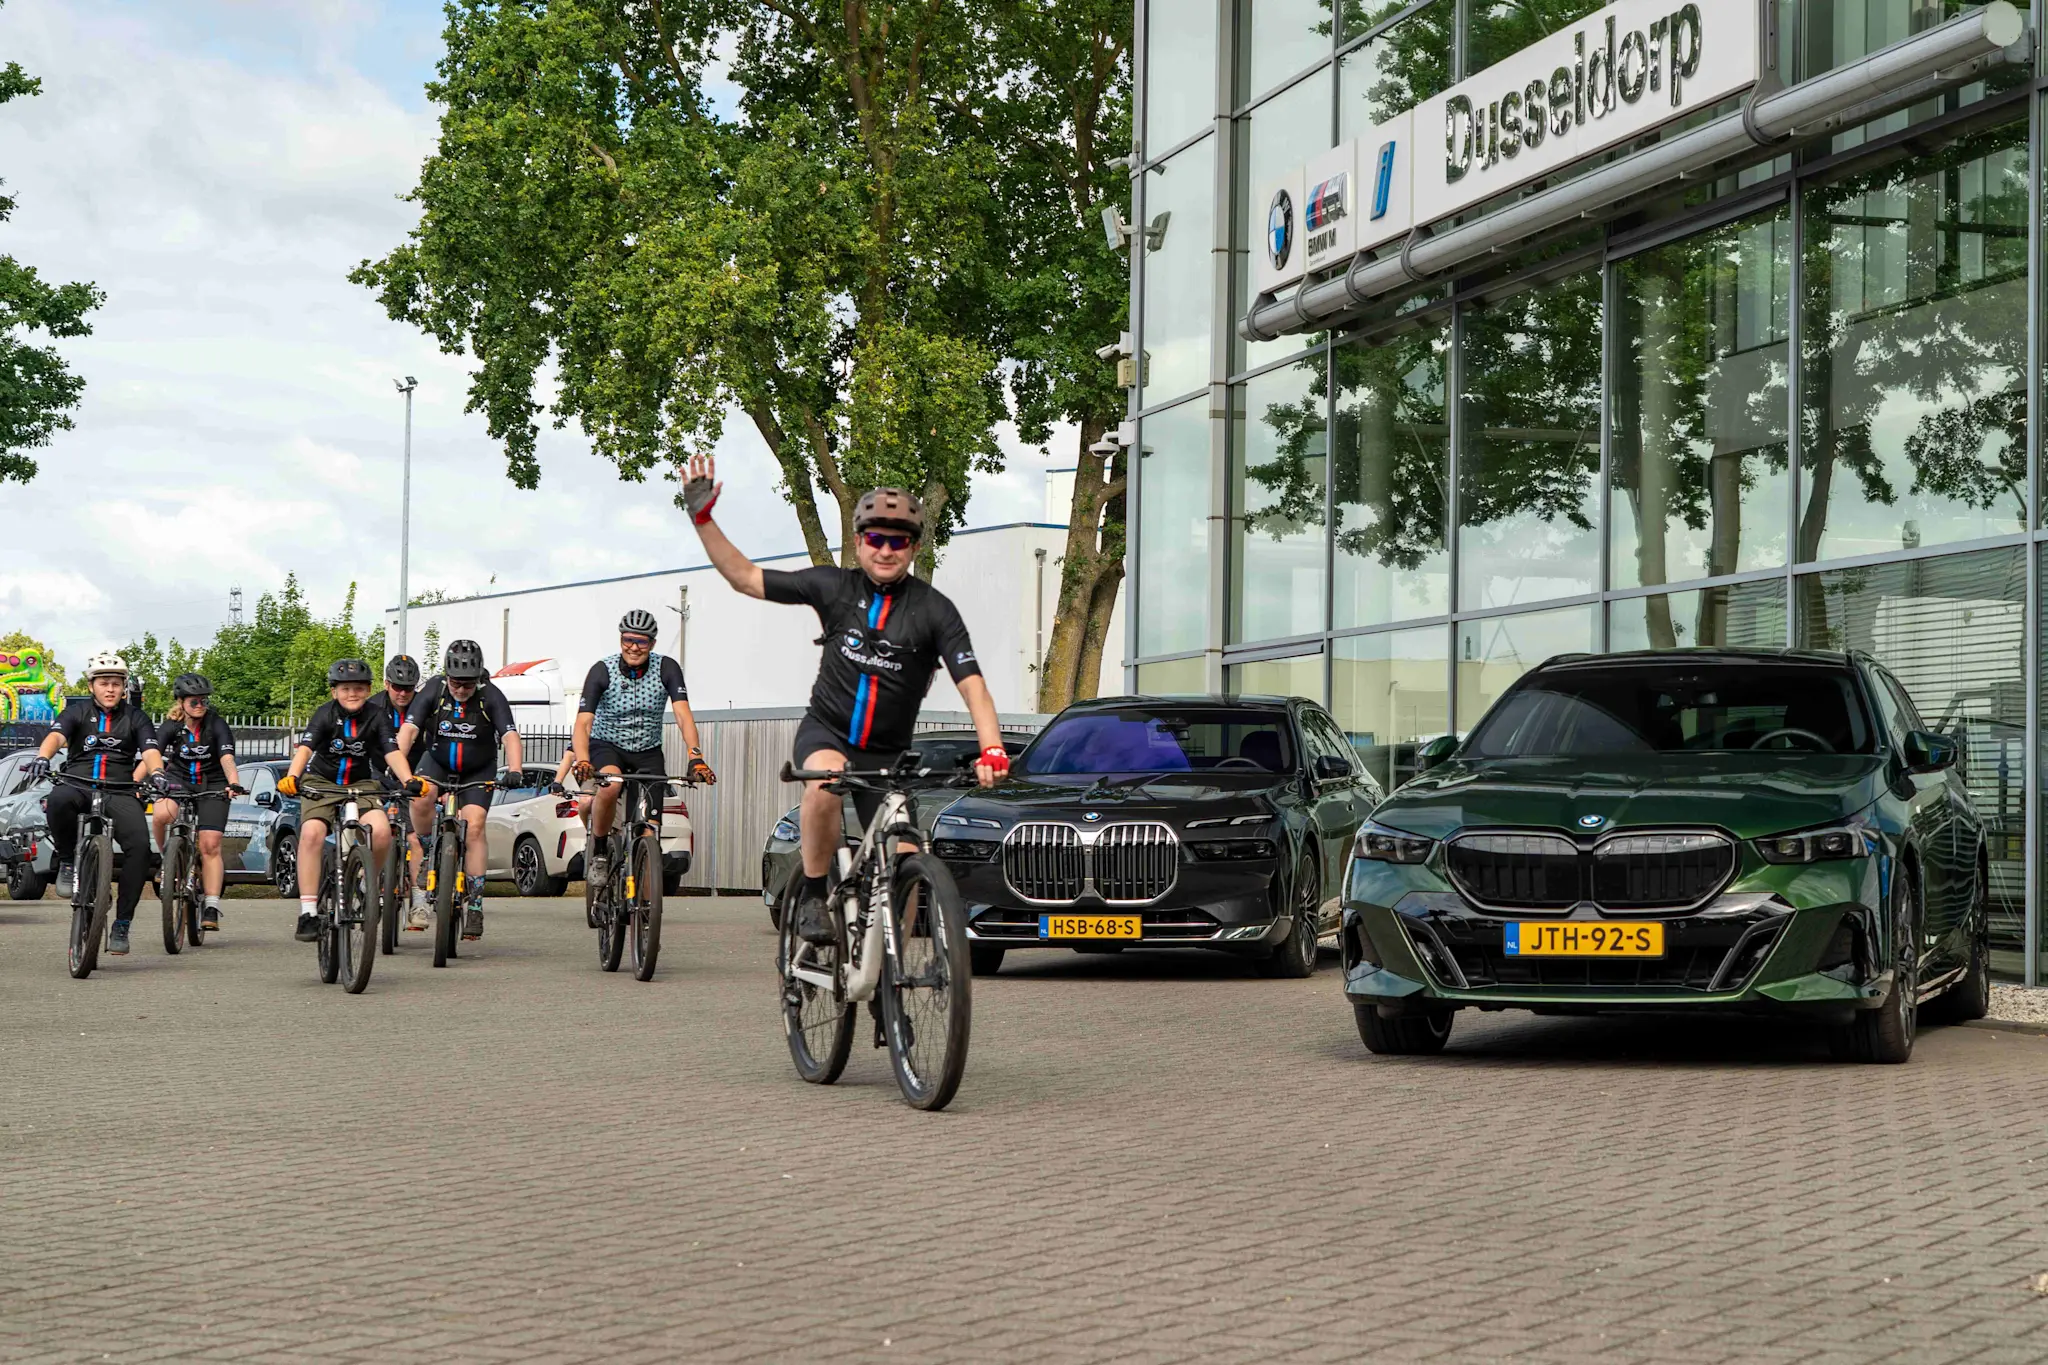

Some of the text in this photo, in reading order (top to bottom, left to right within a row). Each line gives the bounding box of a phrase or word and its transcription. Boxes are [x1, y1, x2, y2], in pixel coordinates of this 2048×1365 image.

[1446, 3, 1702, 185] Dusseldorp
[1308, 227, 1337, 257] BMW M
[437, 729, 477, 740] Dusseldorp
[1053, 919, 1134, 935] HSB-68-S
[1507, 927, 1651, 951] NL JTH-92-S
